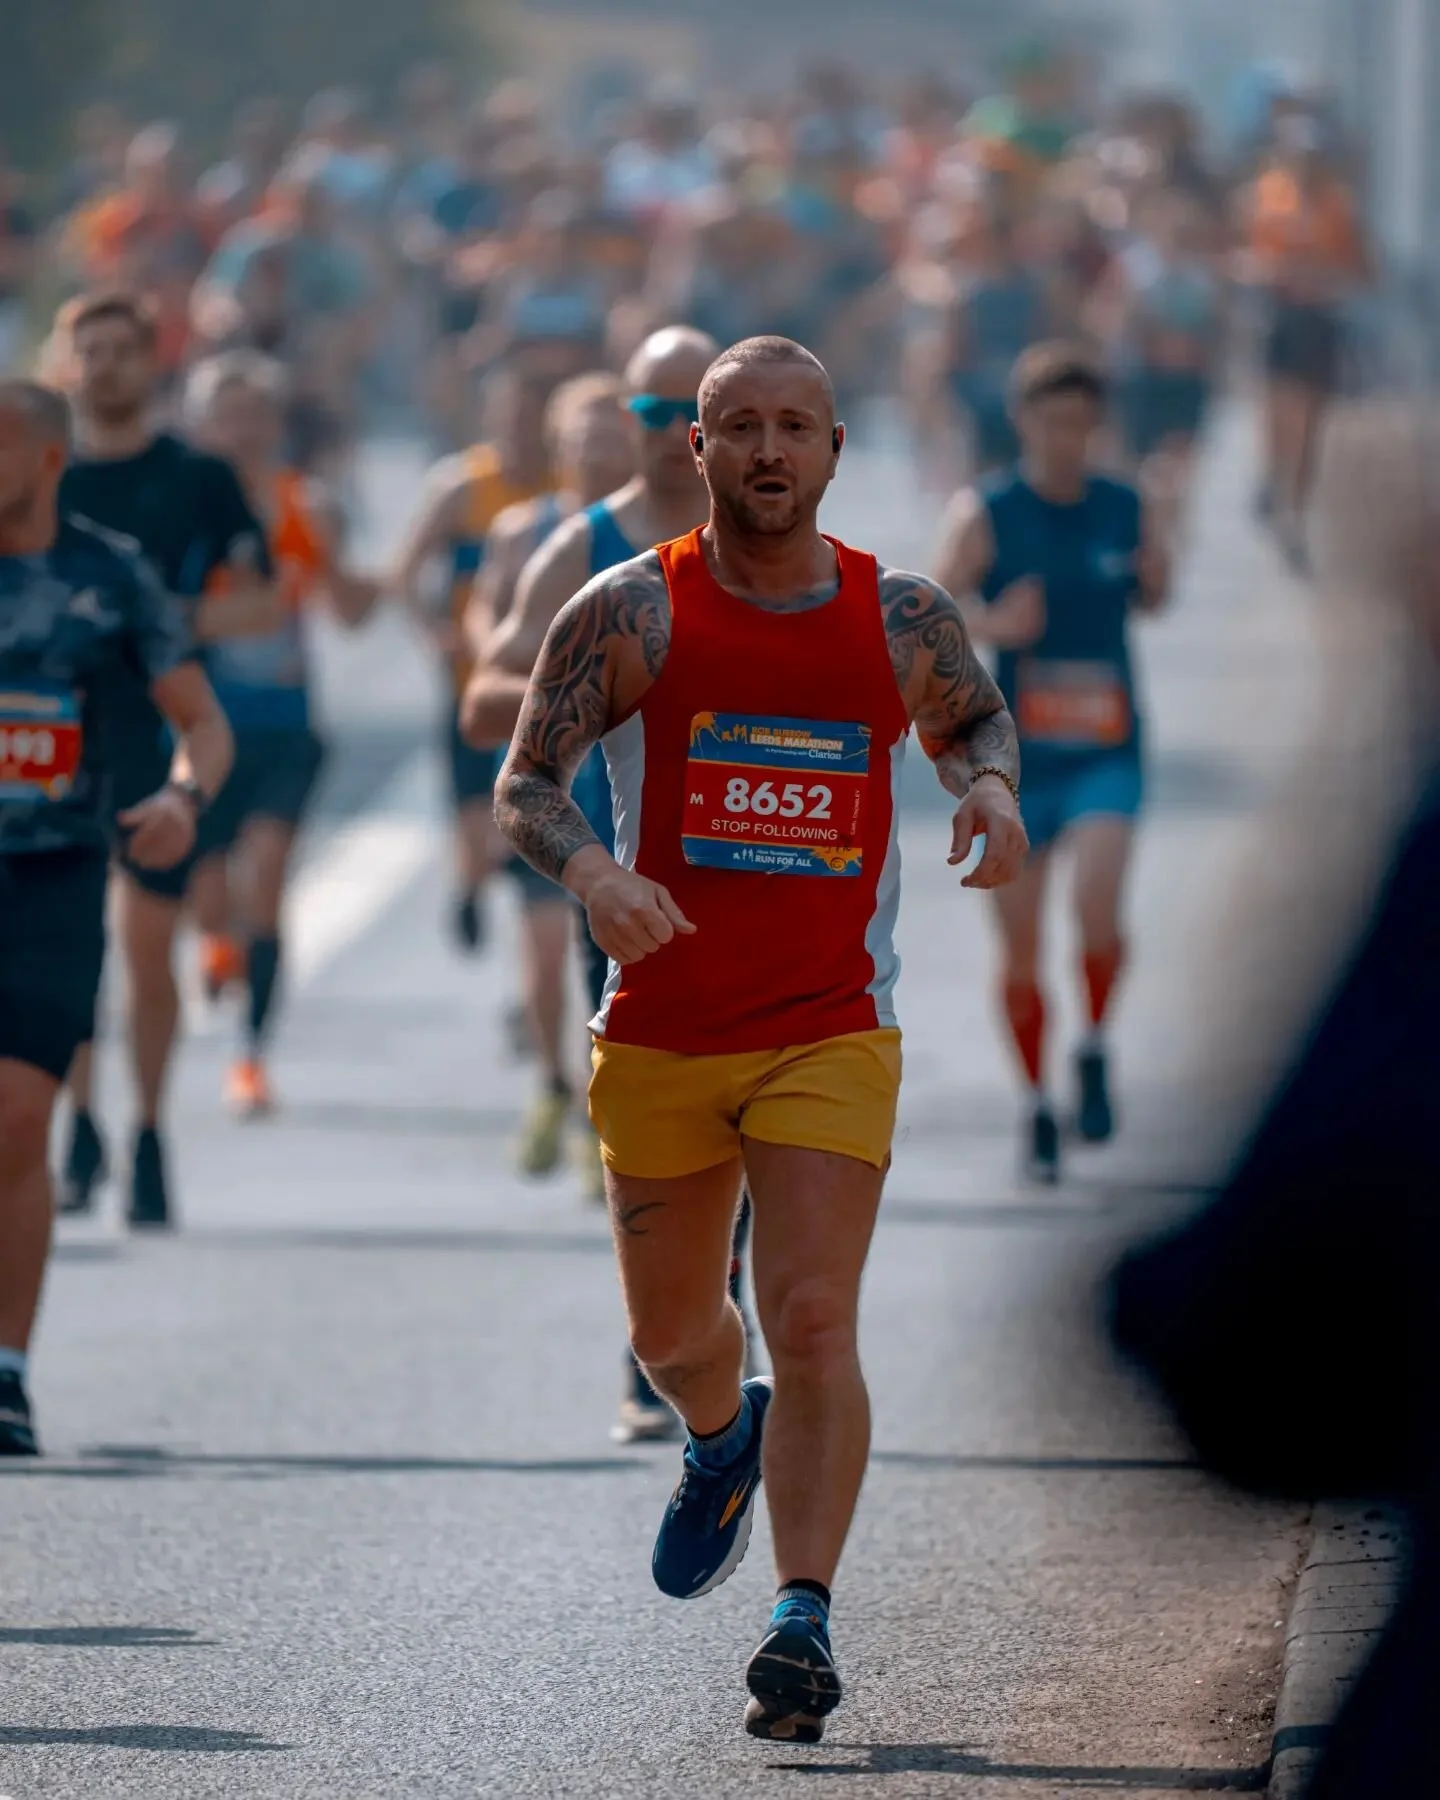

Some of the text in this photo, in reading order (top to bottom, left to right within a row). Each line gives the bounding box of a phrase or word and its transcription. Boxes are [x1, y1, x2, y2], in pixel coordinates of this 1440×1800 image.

[750, 734, 844, 751] LEEDS MARATHON
[808, 748, 842, 761] Clarion
[689, 792, 704, 805] M
[723, 777, 833, 820] 8652
[711, 819, 839, 841] STOP FOLLOWING
[755, 855, 812, 868] RUN FOR ALL
